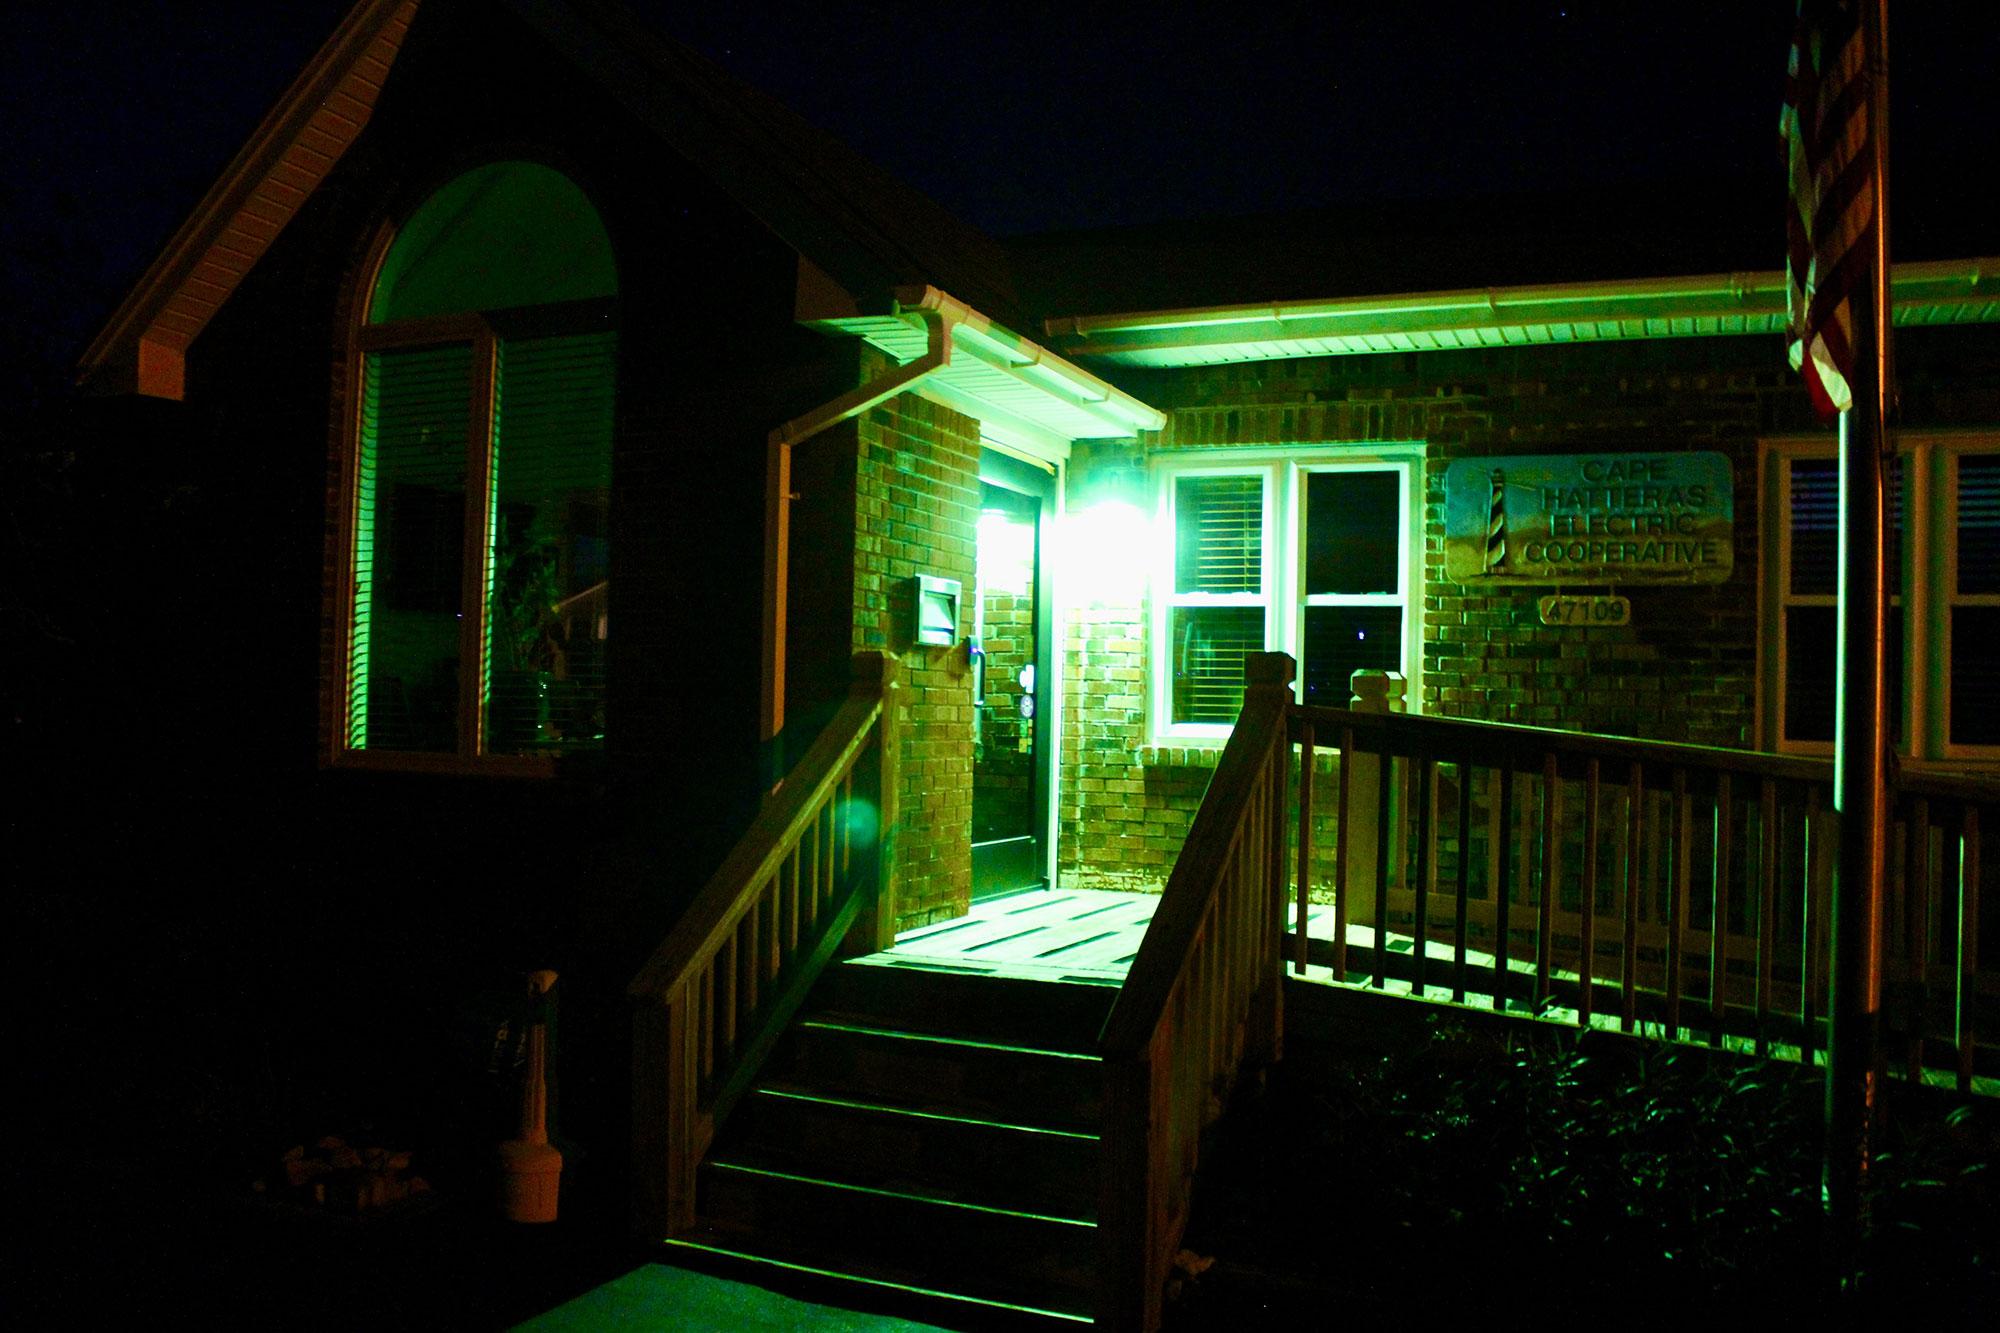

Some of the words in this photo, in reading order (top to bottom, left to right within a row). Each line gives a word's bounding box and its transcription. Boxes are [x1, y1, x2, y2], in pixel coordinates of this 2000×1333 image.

[1581, 459, 1669, 482] CAPE
[1541, 485, 1707, 509] HATTERAS
[1549, 511, 1695, 536] ELECTRIC
[1523, 541, 1718, 563] COOPERATIVE
[1547, 600, 1625, 621] 47109
